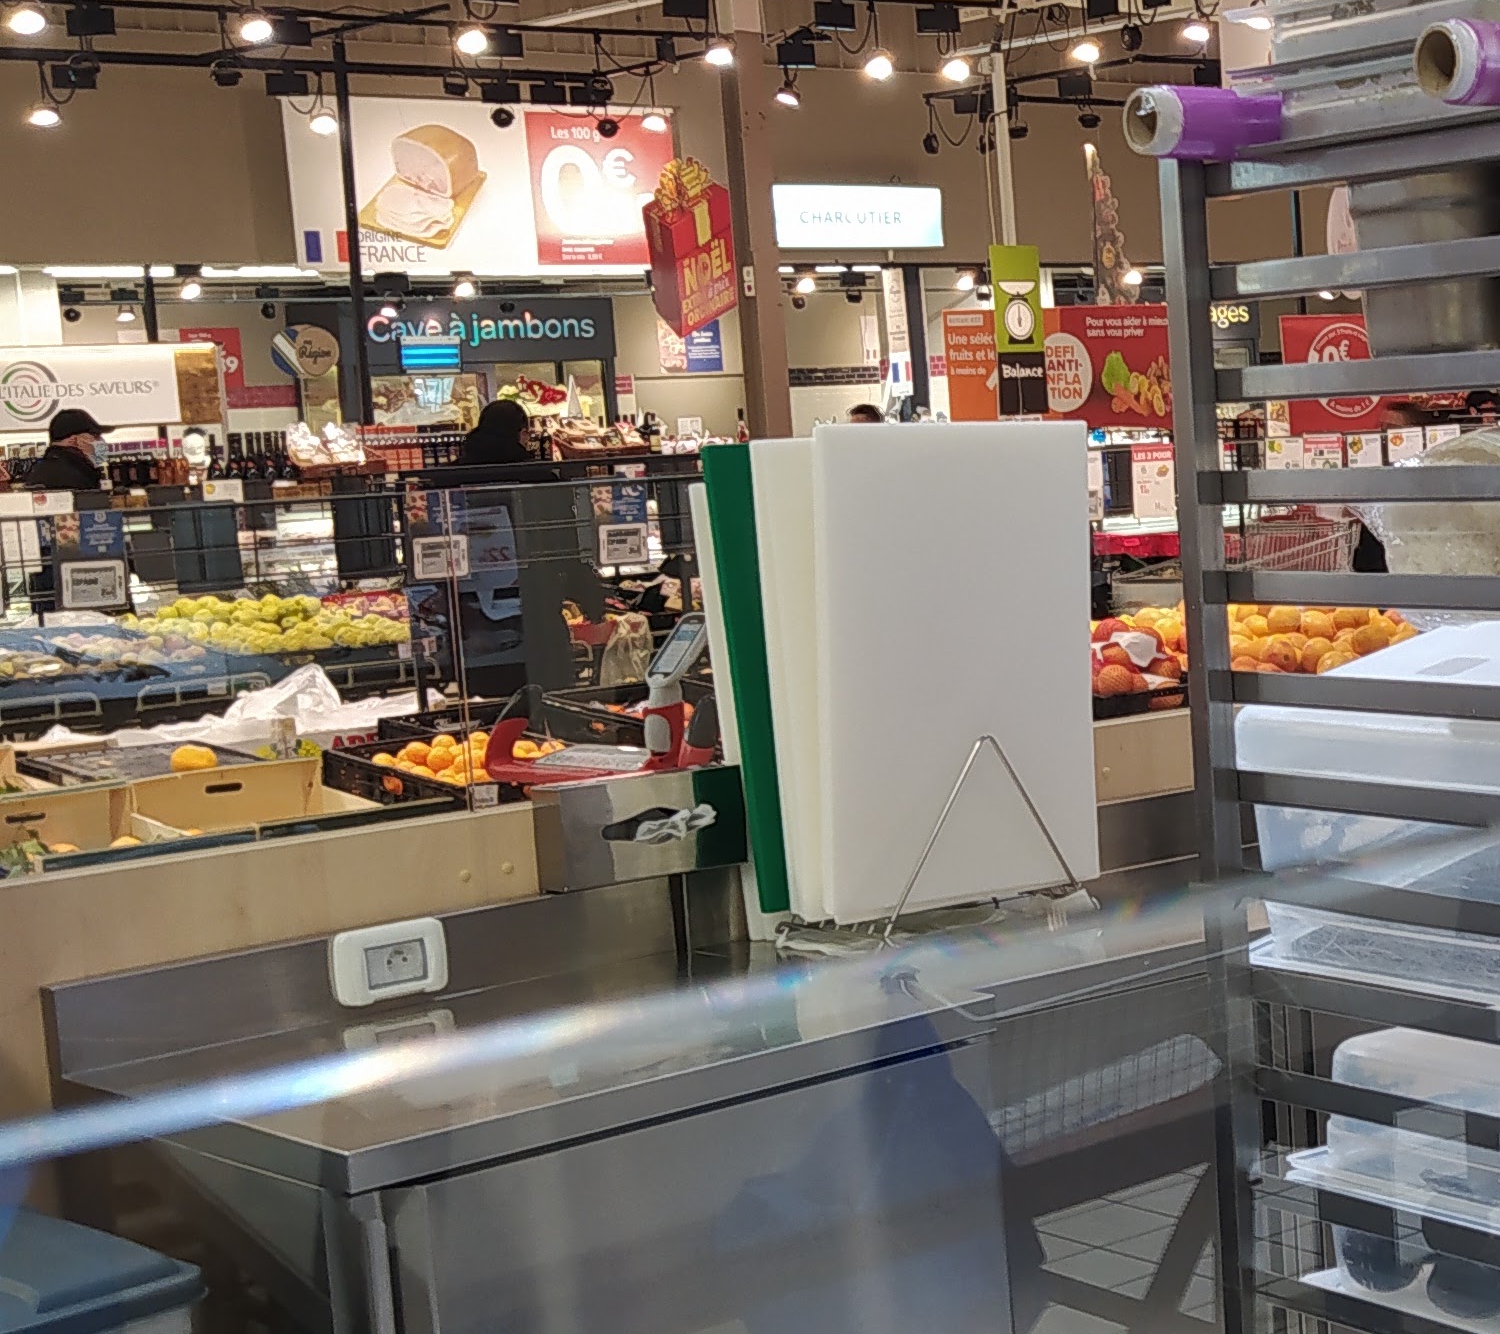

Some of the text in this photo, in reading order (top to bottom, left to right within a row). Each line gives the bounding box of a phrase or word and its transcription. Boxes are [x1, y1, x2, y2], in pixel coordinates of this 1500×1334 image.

[551, 126, 570, 139] Les
[571, 126, 591, 139] 100
[358, 231, 403, 243] ORIGINE
[359, 245, 427, 263] FRANCE
[683, 238, 732, 297] NOËL
[1086, 316, 1104, 326] Pour
[367, 311, 596, 348] Cave à jambons
[948, 332, 968, 345] Une
[949, 348, 974, 361] fruits
[975, 349, 986, 361] et
[1045, 345, 1075, 359] DEFI
[1001, 363, 1044, 379] Balance
[1047, 358, 1083, 372] ANTI-
[0, 384, 51, 400] L'ITALIE
[55, 383, 85, 398] DES
[1051, 387, 1083, 400] TION
